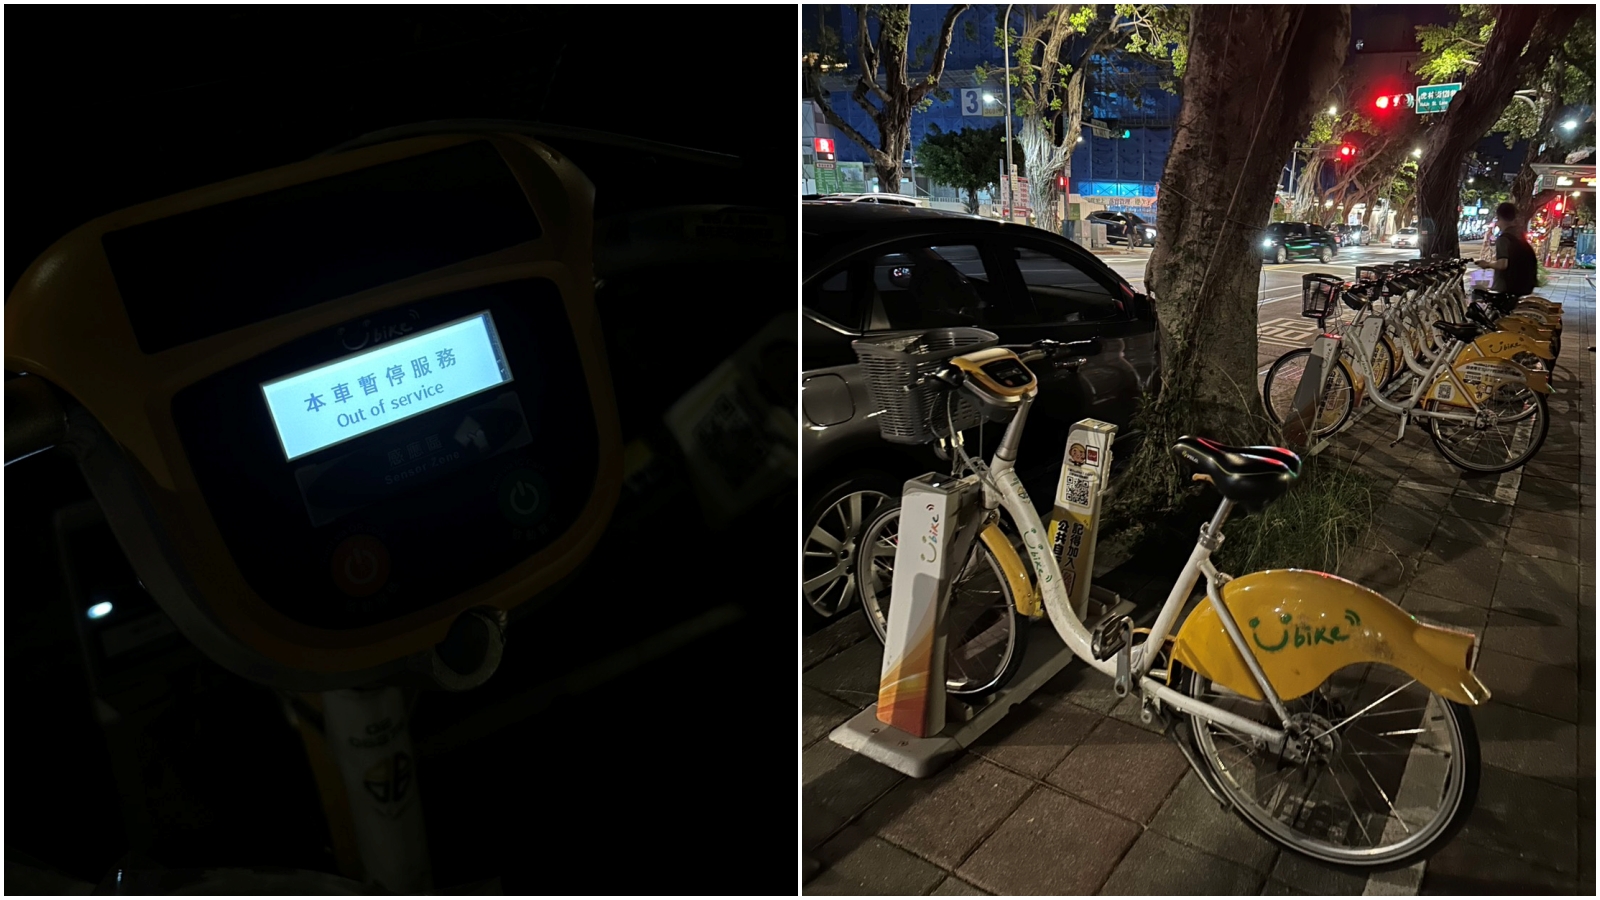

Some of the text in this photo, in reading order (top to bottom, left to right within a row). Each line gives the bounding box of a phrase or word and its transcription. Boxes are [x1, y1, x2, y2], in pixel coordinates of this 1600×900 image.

[965, 90, 979, 114] 3
[303, 347, 457, 414] 本車暫停服務
[336, 382, 445, 428] Out of service
[384, 450, 460, 486] Sensor Zone
[1065, 522, 1084, 570] 記得加入
